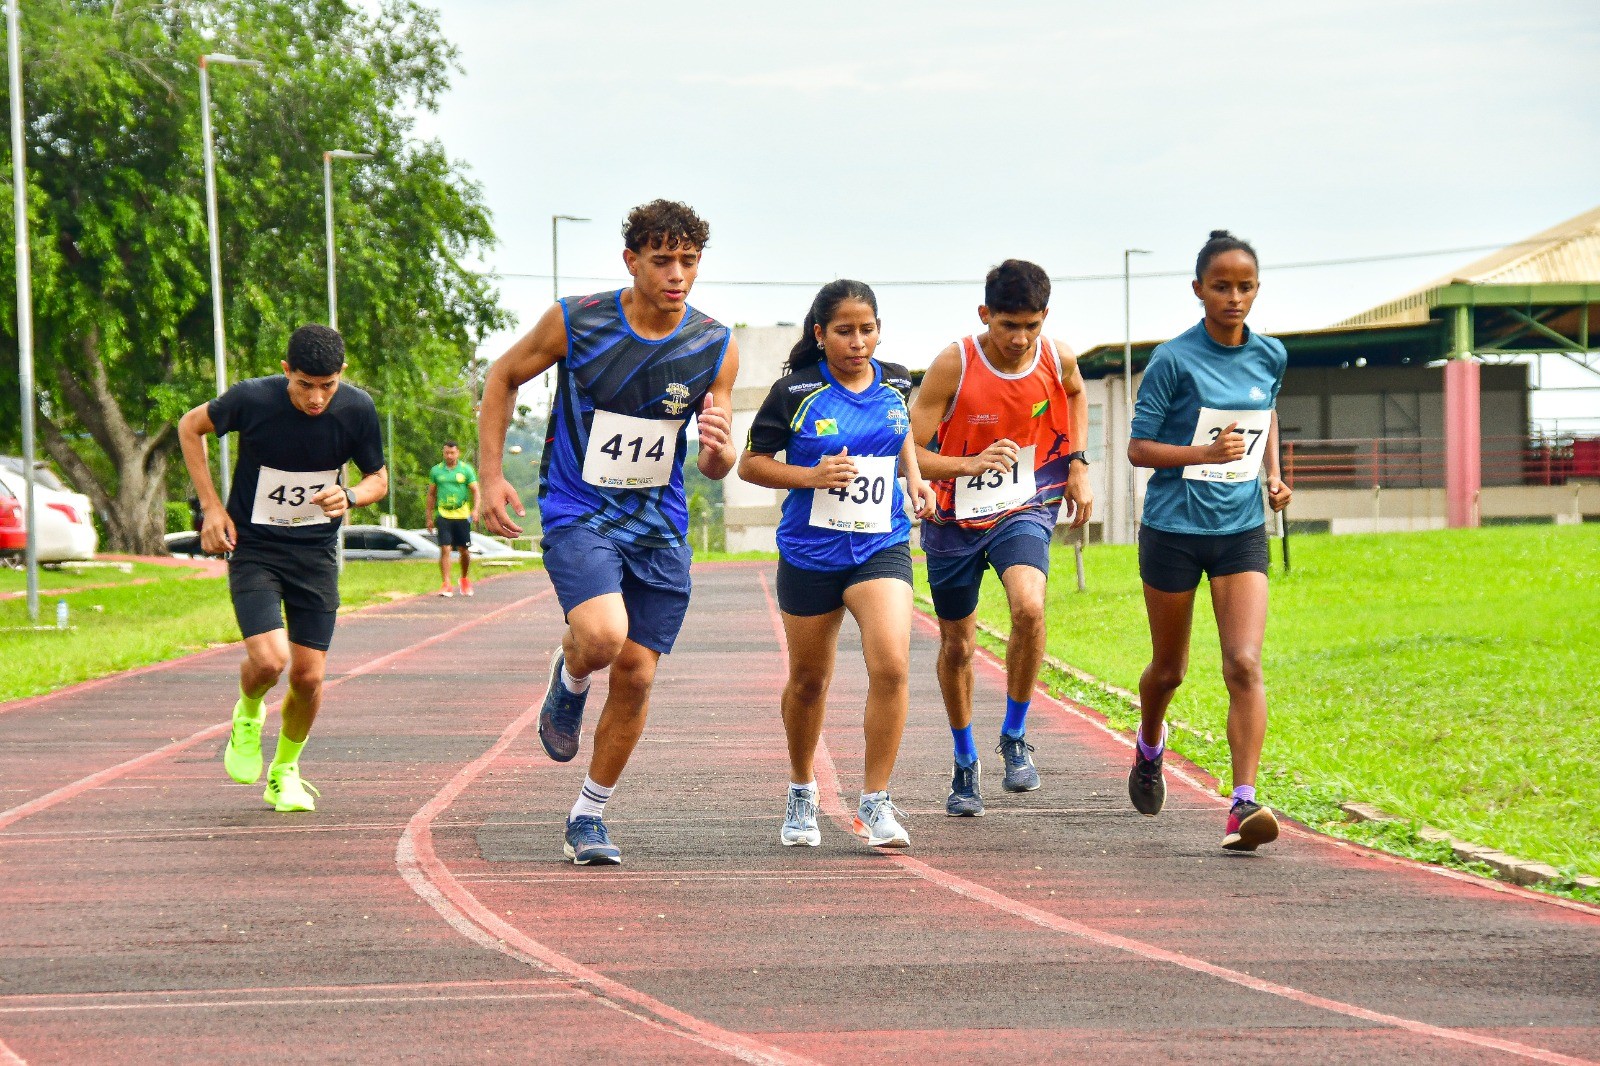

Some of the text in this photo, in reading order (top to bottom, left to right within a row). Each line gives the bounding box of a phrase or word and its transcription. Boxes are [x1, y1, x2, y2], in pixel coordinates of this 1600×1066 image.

[600, 433, 665, 463] 414
[967, 461, 1019, 491] 431
[268, 483, 325, 507] 437
